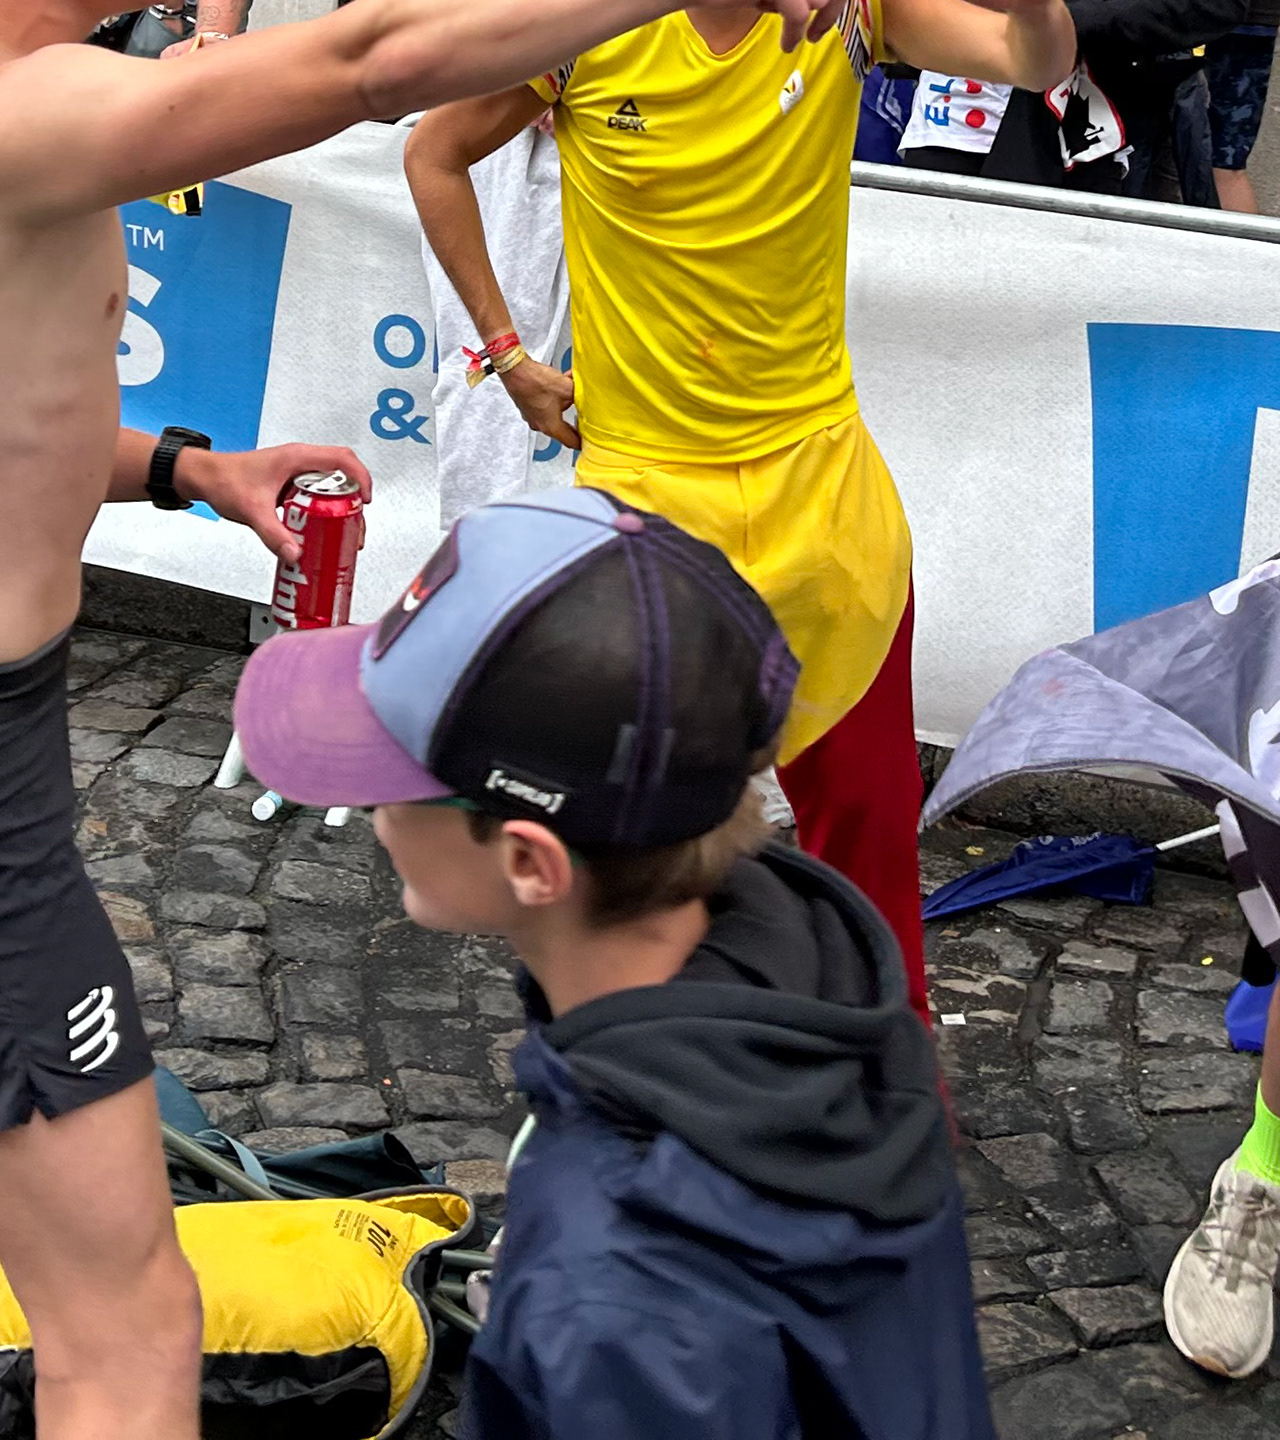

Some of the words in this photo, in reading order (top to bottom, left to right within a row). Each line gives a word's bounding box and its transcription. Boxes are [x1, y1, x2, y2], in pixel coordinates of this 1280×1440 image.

[607, 116, 649, 133] PEAK
[126, 224, 165, 251] TM
[370, 387, 432, 445] &
[271, 491, 313, 629] Juper
